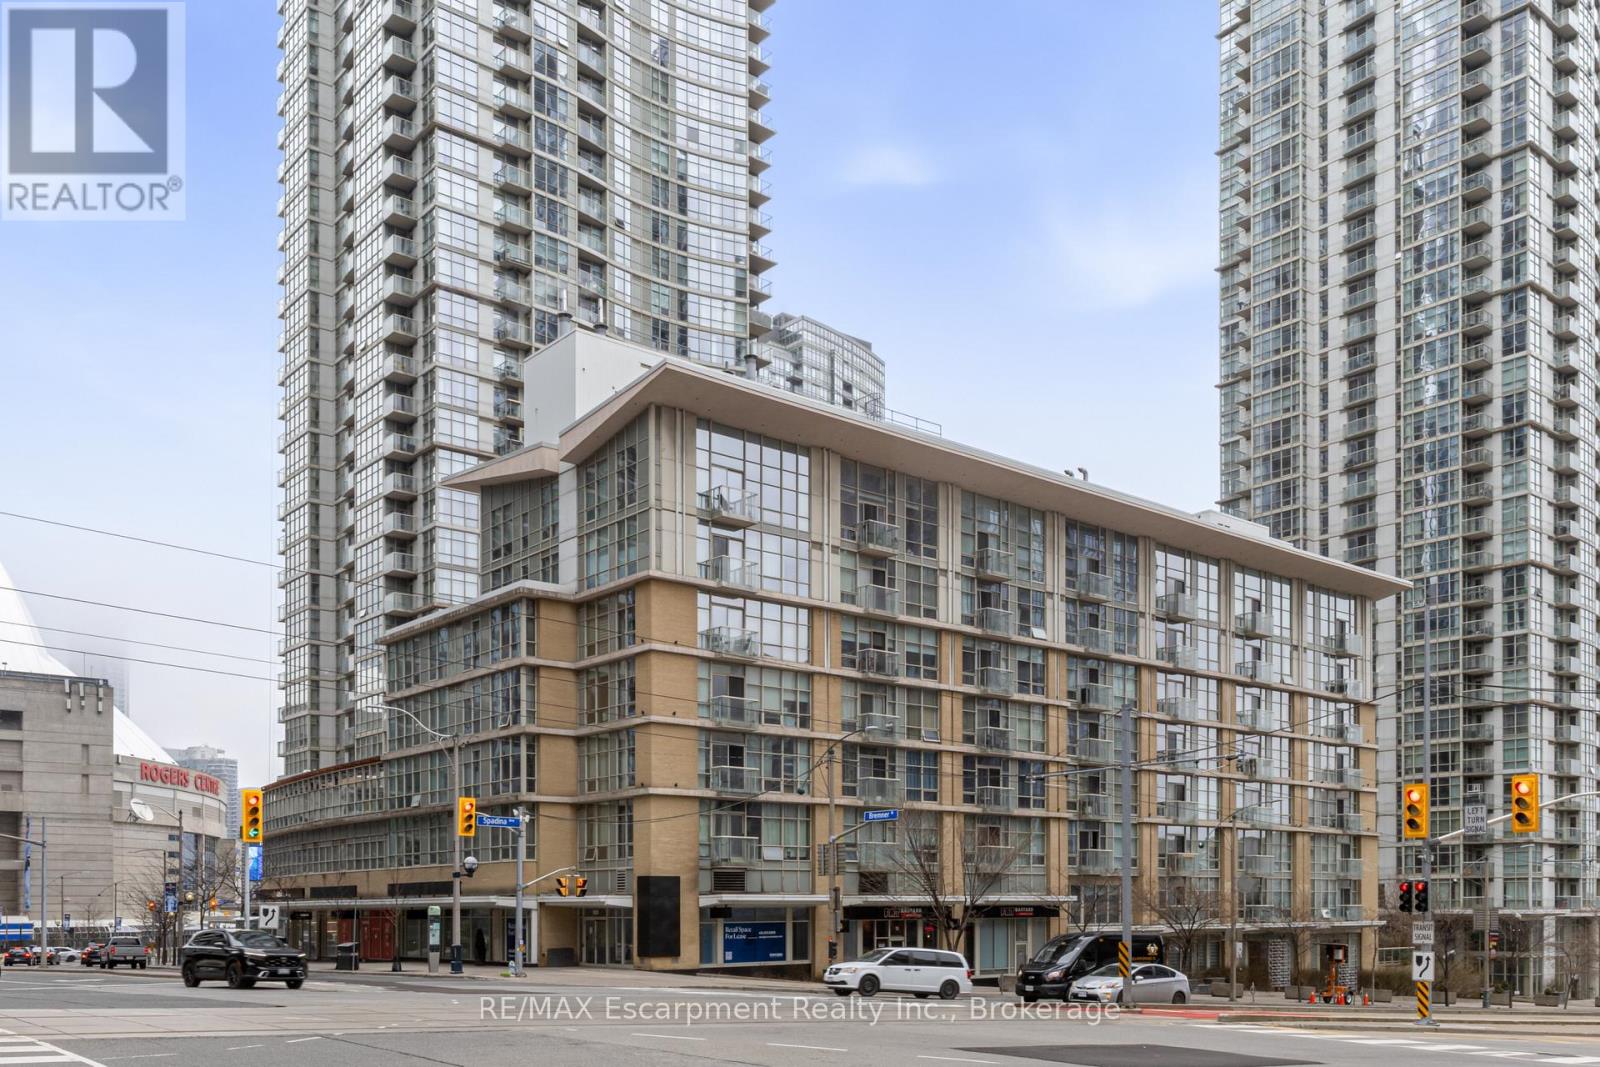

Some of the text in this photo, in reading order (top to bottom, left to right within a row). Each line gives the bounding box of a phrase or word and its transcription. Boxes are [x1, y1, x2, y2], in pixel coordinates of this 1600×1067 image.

[140, 762, 190, 788] ROGERS
[1467, 807, 1484, 815] LEFT
[869, 812, 890, 820] Bremner
[1467, 816, 1485, 824] TURN
[483, 817, 507, 825] Spadina
[1413, 923, 1433, 931] TRANSIT
